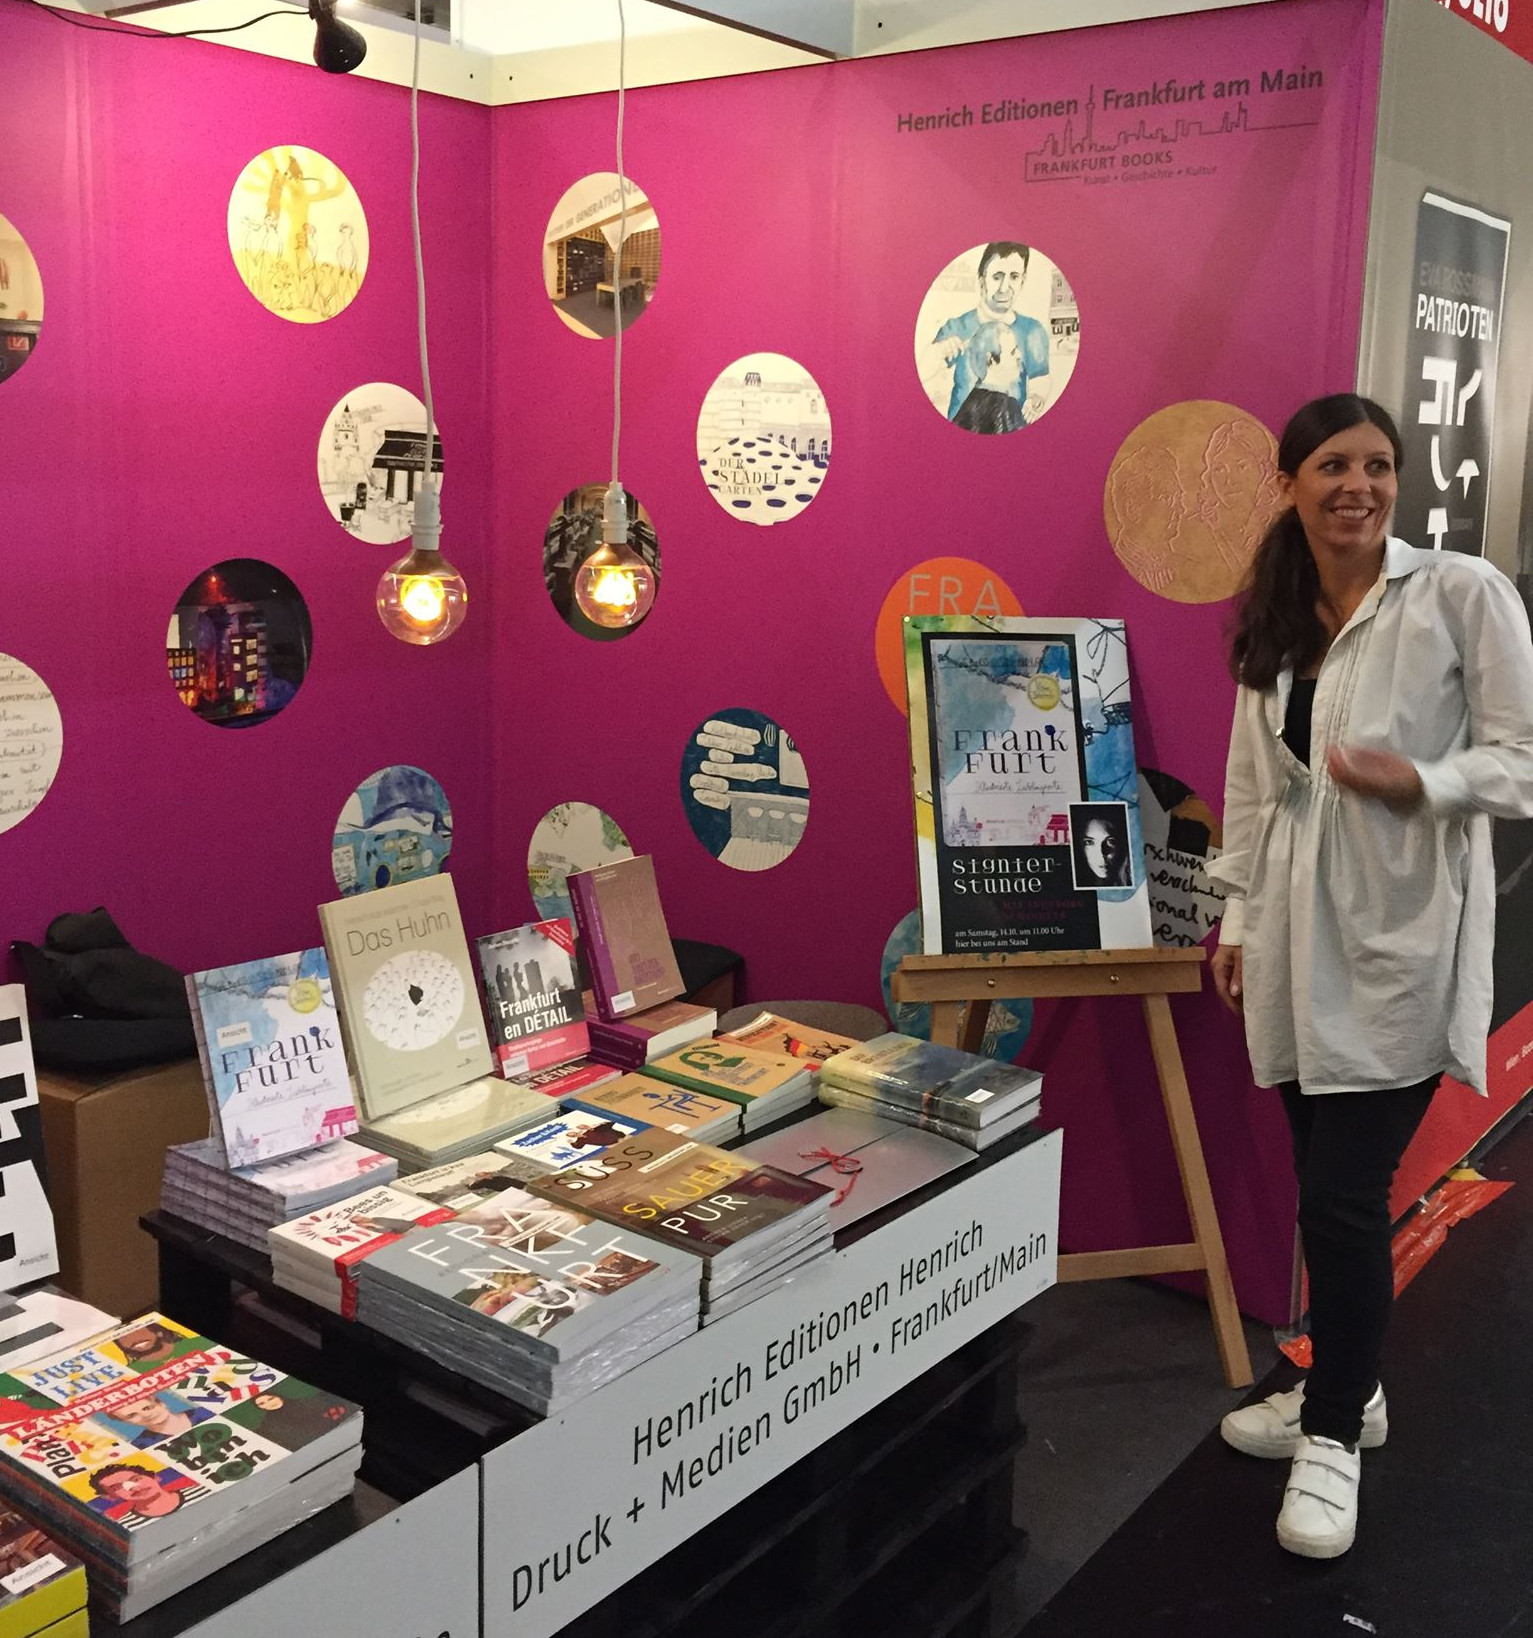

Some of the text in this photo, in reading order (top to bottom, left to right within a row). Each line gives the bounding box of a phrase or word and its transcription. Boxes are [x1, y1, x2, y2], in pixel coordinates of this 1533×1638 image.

[897, 65, 1324, 133] Henrich Editionen Frankfurt am Main
[1033, 150, 1173, 176] FRANKFURT BOOKS
[1415, 293, 1494, 341] PATRIOTEN
[910, 573, 1002, 615] FRA
[347, 911, 451, 956] Das Huhn
[955, 939, 969, 948] hier
[1009, 938, 1029, 947] Stand
[1051, 926, 1065, 934] Uhr
[499, 988, 562, 1019] Frankfurt
[504, 1022, 521, 1039] en
[524, 1005, 573, 1035] DÉTAIL
[623, 1159, 746, 1219] SAUER
[661, 1194, 749, 1234] PUR
[633, 1220, 983, 1465] Henrich Editionen Henrich
[32, 1351, 101, 1387] JUST
[50, 1364, 124, 1399] LIVE
[513, 1514, 612, 1612] Druck
[660, 1410, 771, 1510] Medien
[783, 1344, 862, 1428] GmbH
[890, 1232, 1046, 1354] Frankfurt/Main
